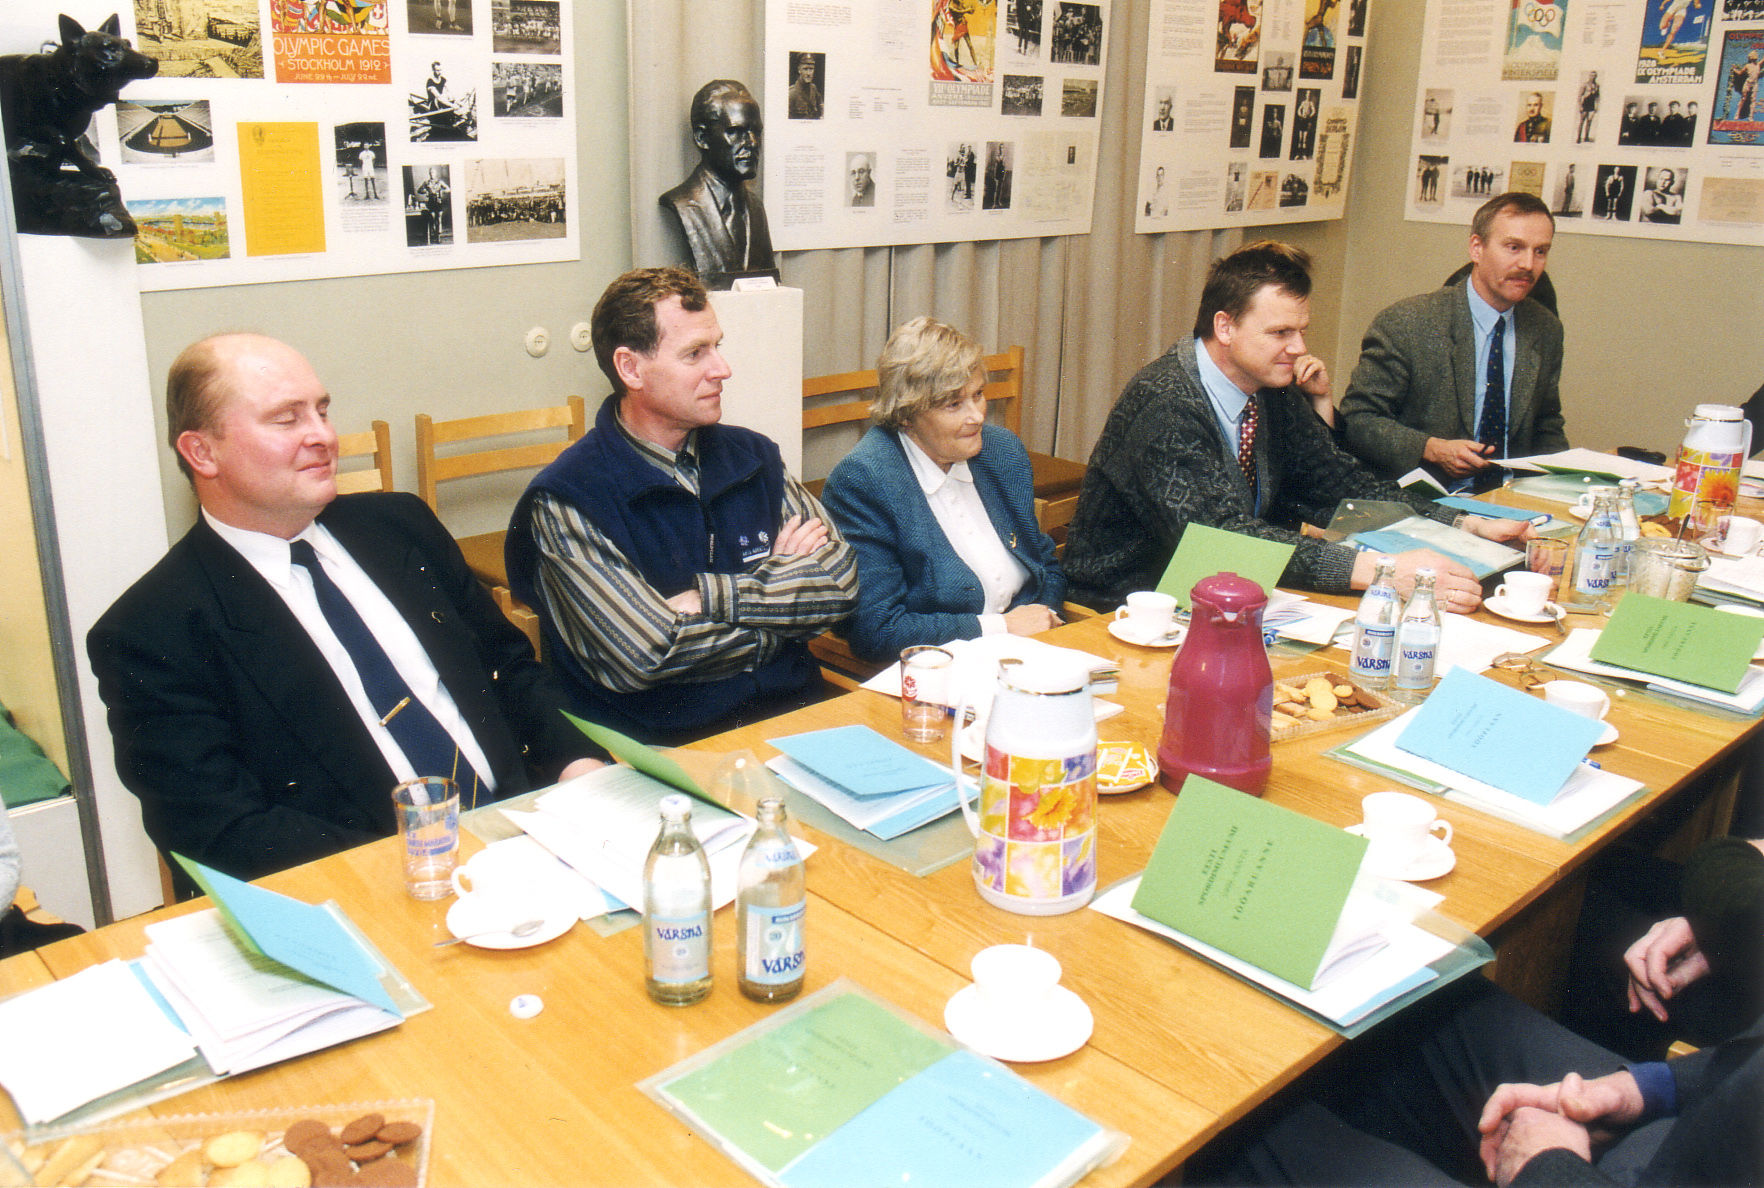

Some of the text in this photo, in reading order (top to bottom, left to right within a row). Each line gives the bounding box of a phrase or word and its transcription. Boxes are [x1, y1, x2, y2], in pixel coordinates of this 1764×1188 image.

[273, 37, 391, 58] OLYMPIC GAMES
[288, 58, 382, 71] STOCKHOLM 1912
